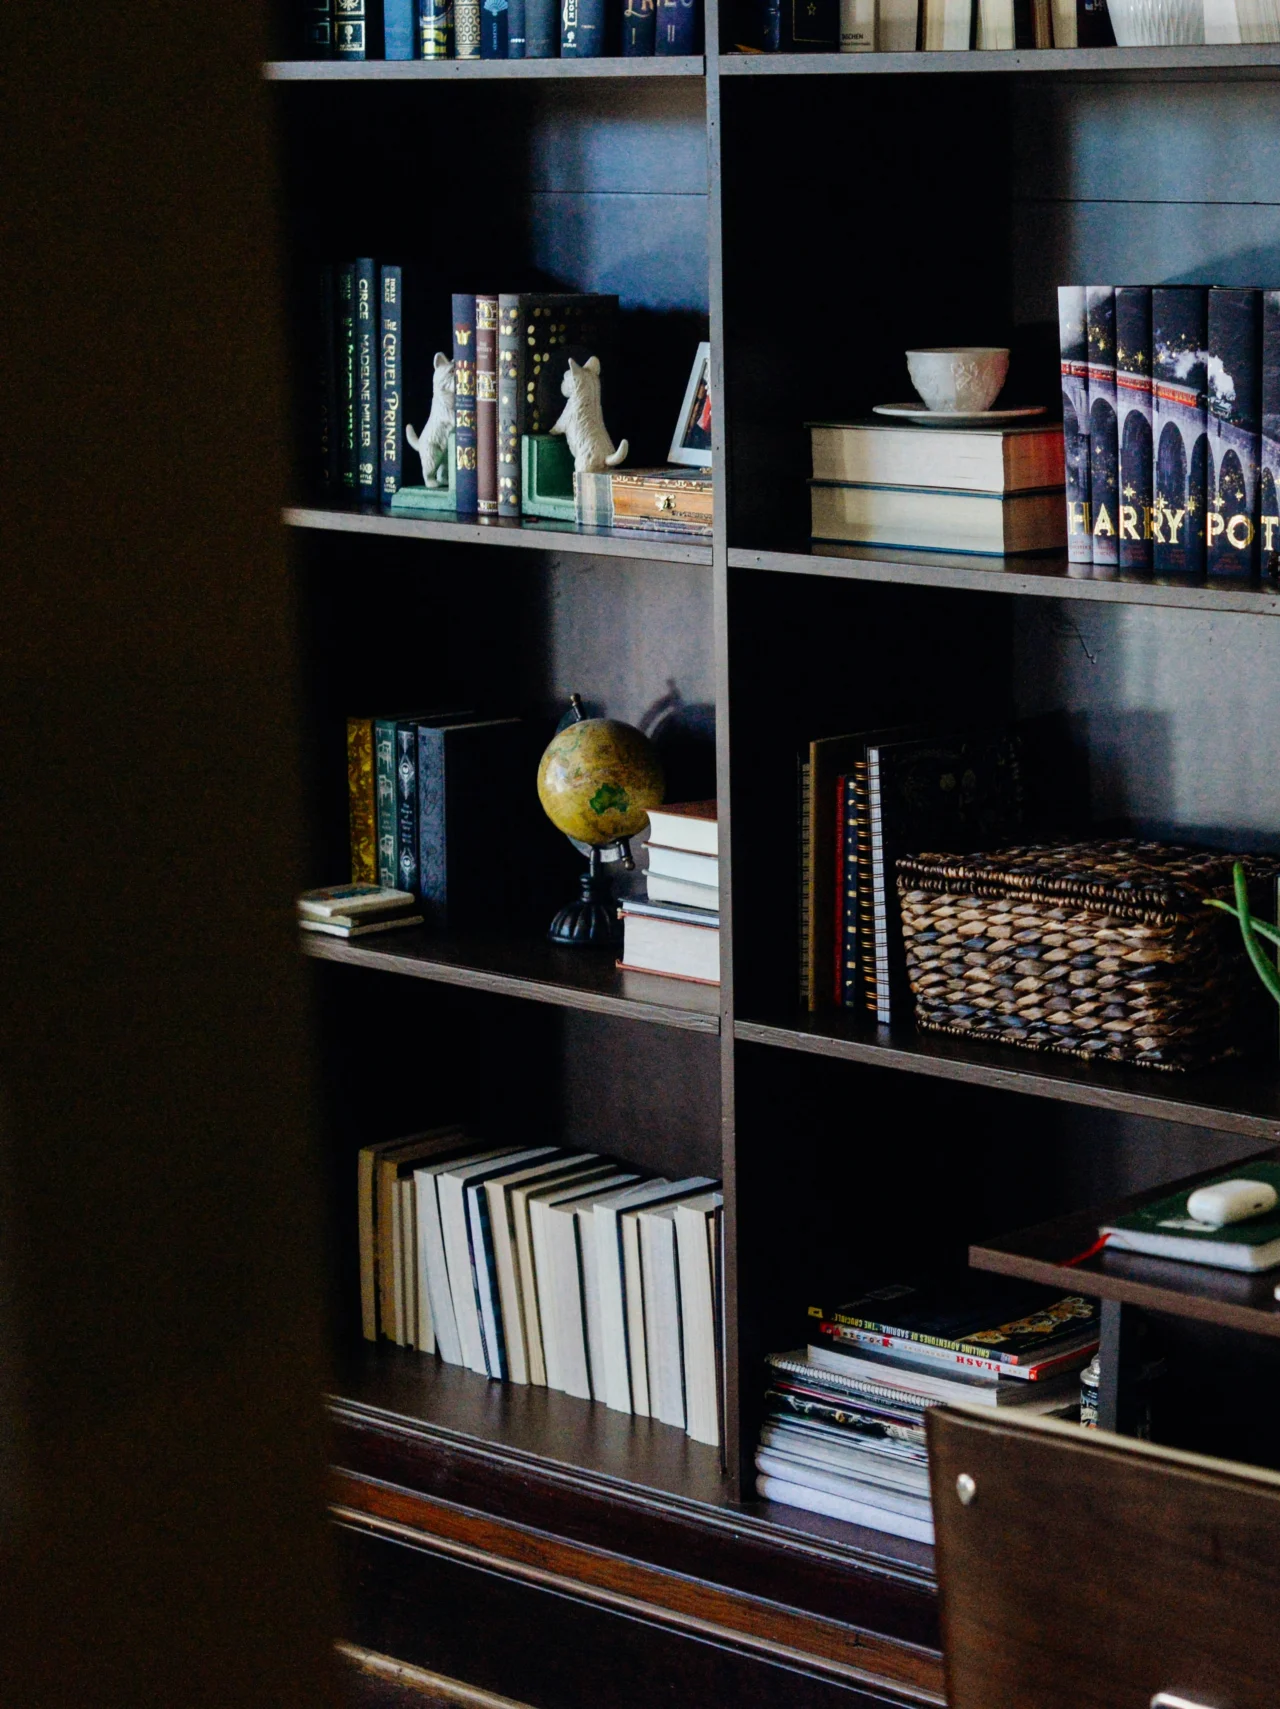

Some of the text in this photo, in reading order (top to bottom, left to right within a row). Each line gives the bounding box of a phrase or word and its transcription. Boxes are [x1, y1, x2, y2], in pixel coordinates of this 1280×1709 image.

[359, 278, 369, 320] CIRCE
[360, 334, 371, 447] MADELINE MILLER
[383, 333, 399, 461] CRUEL PRINCE
[1067, 502, 1185, 544] HARRY
[911, 1331, 919, 1341] OF
[919, 1334, 960, 1353] ADVENTURES
[961, 1343, 991, 1359] CHILLING
[955, 1355, 1001, 1373] FLASH
